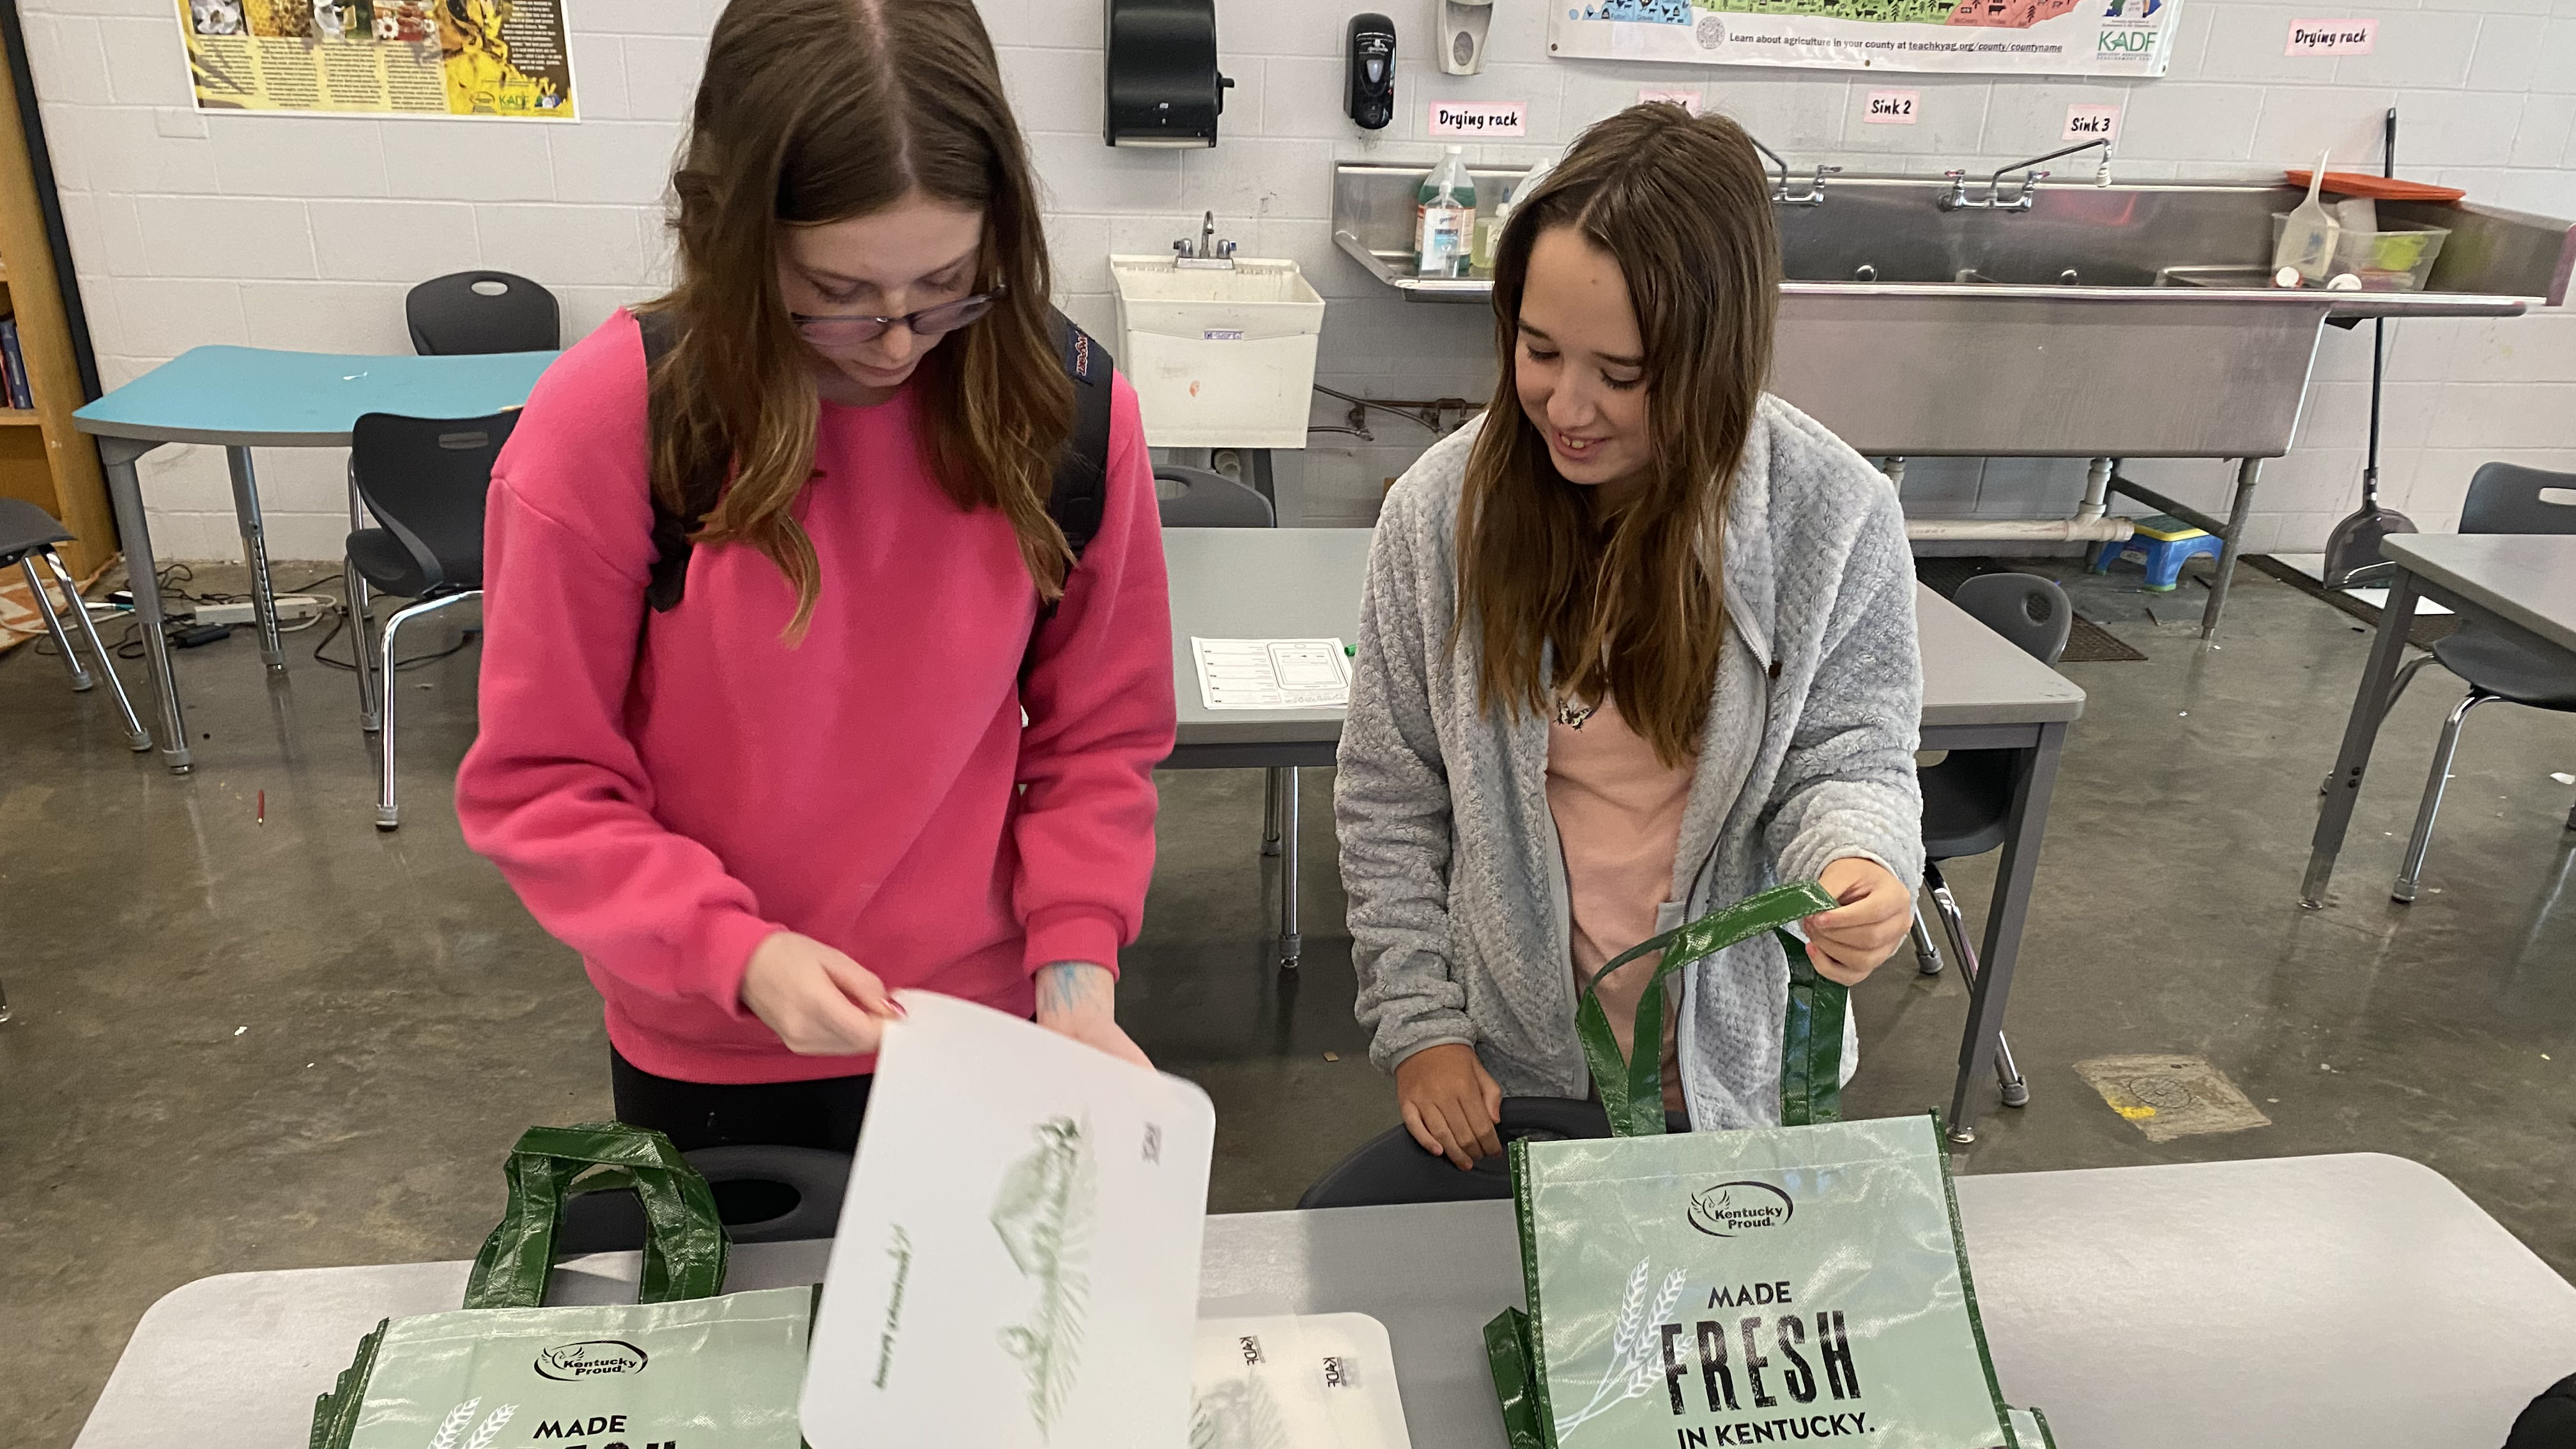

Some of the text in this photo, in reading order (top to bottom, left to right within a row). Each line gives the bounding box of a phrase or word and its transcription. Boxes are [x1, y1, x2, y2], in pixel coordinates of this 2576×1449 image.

[1730, 33, 1754, 42] Learn
[1756, 35, 1781, 44] about
[1784, 36, 1831, 46] agriculture
[1834, 38, 1842, 47] in
[1844, 40, 1862, 49] your
[1865, 40, 1895, 50] county
[1909, 41, 2062, 53] teachkyag.org/county/countyname
[2098, 31, 2158, 52] KADF
[2295, 28, 2366, 47] Drying rack
[1871, 98, 1912, 115] Sink 2
[1439, 109, 1518, 129] Drying rack
[2071, 116, 2110, 132] Sink 3
[1714, 1205, 1783, 1220] Kentucky
[1708, 1280, 1792, 1309] MADE
[563, 1358, 638, 1369] Kentucky
[1660, 1310, 1862, 1416] FRESH
[533, 1414, 627, 1439] MADE
[1677, 1412, 1875, 1449] IN KENTUCKY.
